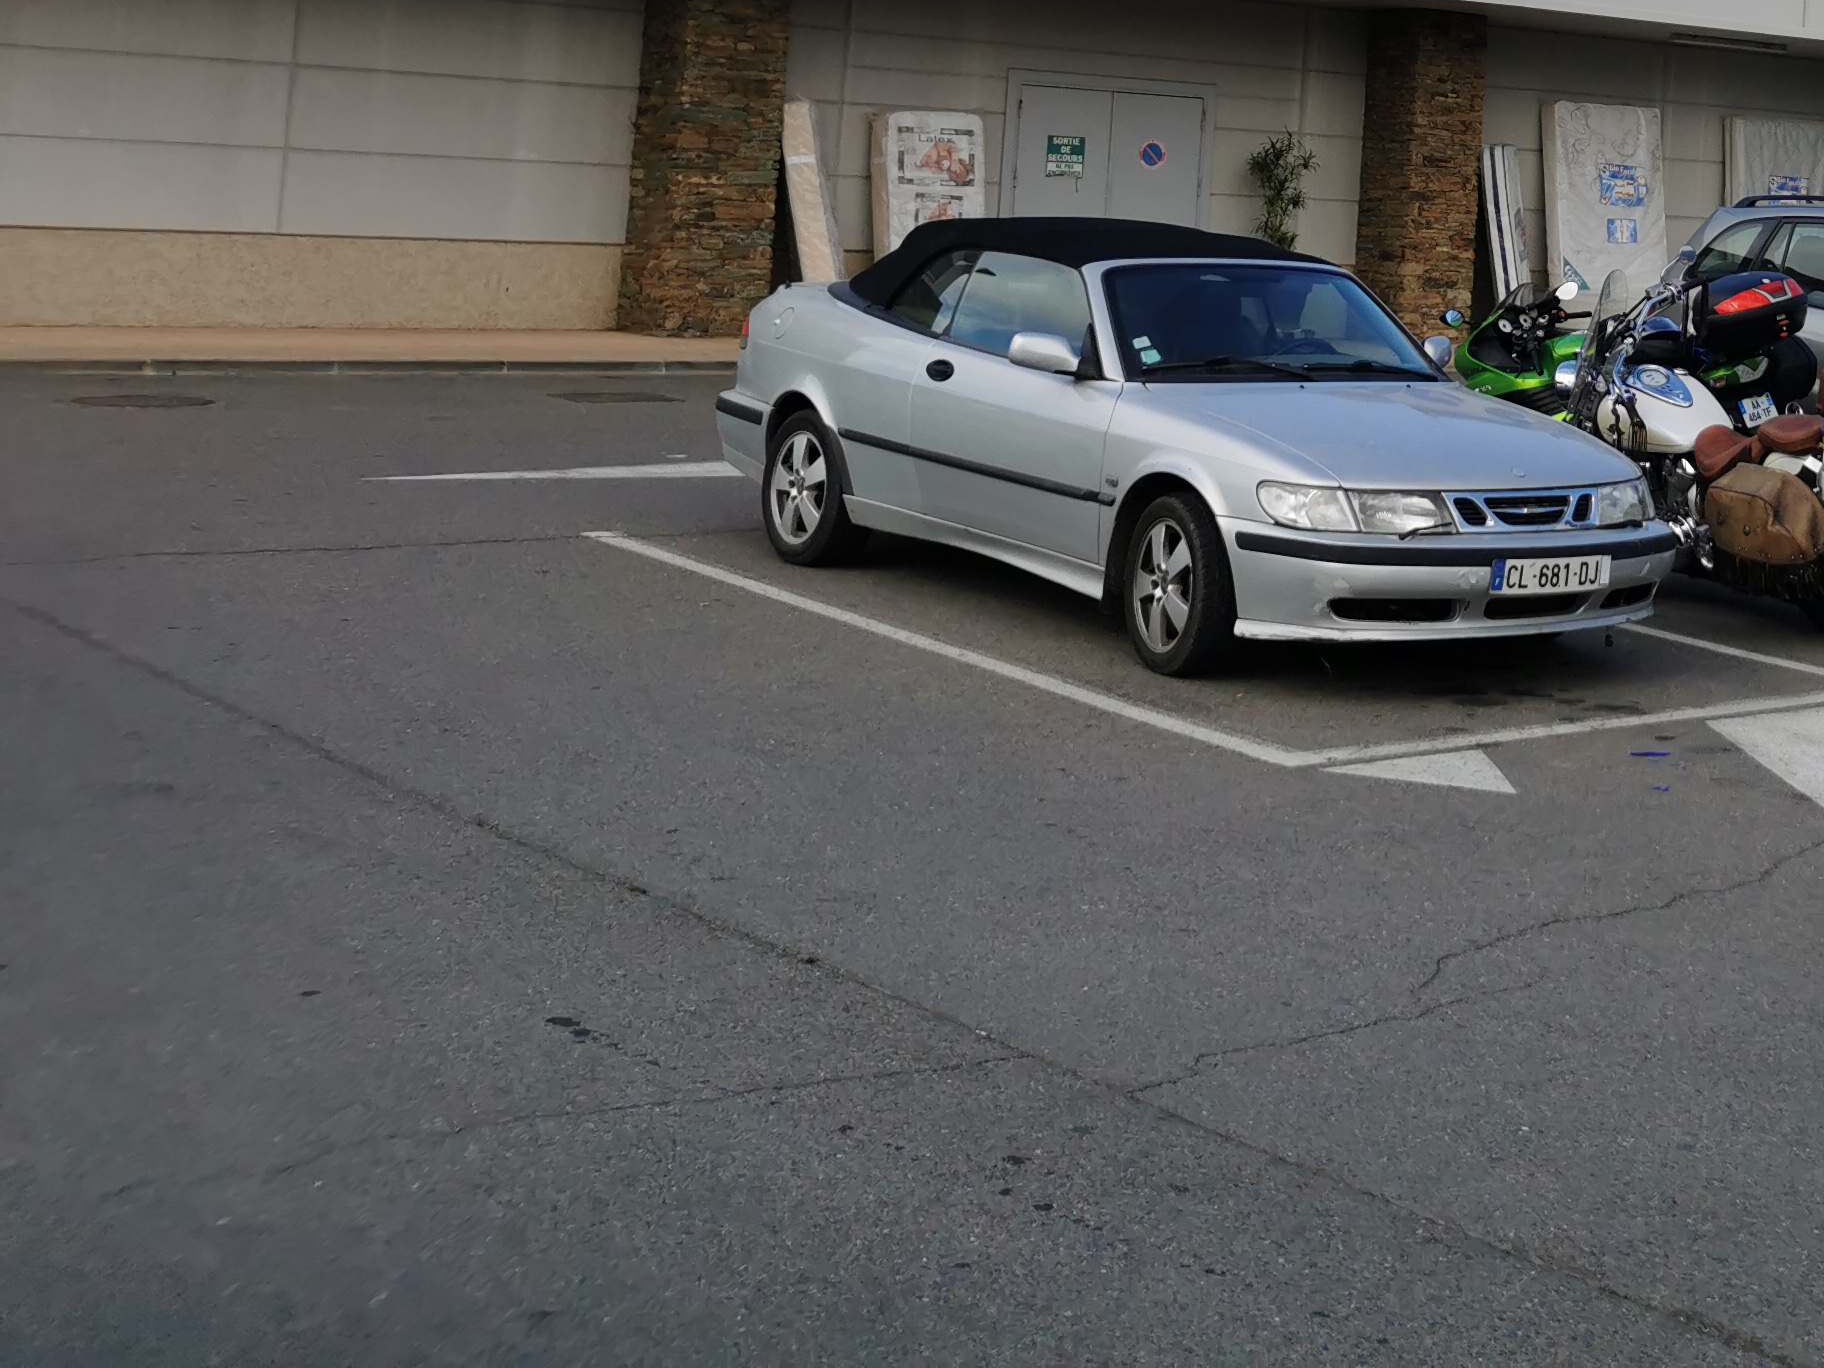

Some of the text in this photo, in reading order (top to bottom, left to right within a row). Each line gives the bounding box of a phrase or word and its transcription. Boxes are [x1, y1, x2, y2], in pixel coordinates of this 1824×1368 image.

[918, 134, 955, 144] Latex
[1052, 137, 1081, 146] SORTIE
[1060, 145, 1072, 154] DE
[1047, 153, 1084, 163] SECOURS
[1506, 560, 1599, 588] CL-681-DJ
